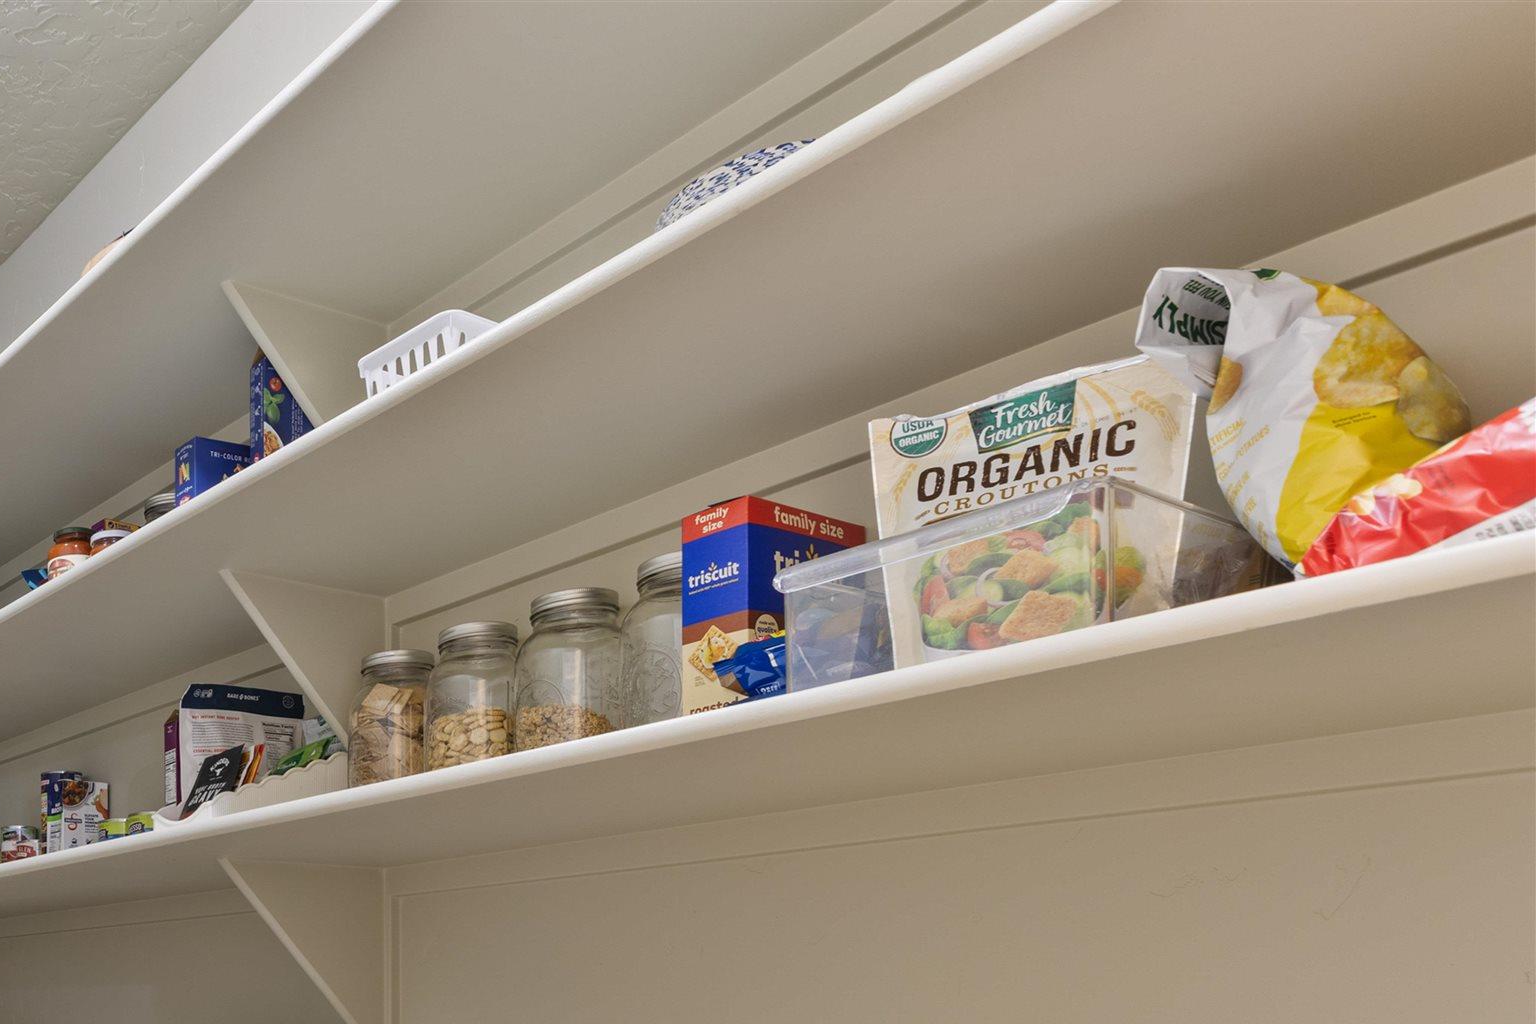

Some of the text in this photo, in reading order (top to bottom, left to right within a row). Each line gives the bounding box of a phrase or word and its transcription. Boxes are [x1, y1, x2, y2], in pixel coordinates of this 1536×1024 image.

[1182, 279, 1205, 294] FEEL
[1153, 295, 1229, 345] SIMPLY
[991, 391, 1055, 428] Fresh
[901, 419, 935, 433] USDA
[978, 401, 1073, 449] Gourmet
[898, 430, 939, 448] ORGANIC
[210, 450, 242, 462] TRI-COLOR
[916, 418, 1137, 503] ORGANIC
[934, 463, 1111, 518] CROUTONS
[694, 505, 730, 526] family
[701, 520, 724, 534] size
[773, 505, 845, 540] family size
[688, 563, 740, 589] triscuit
